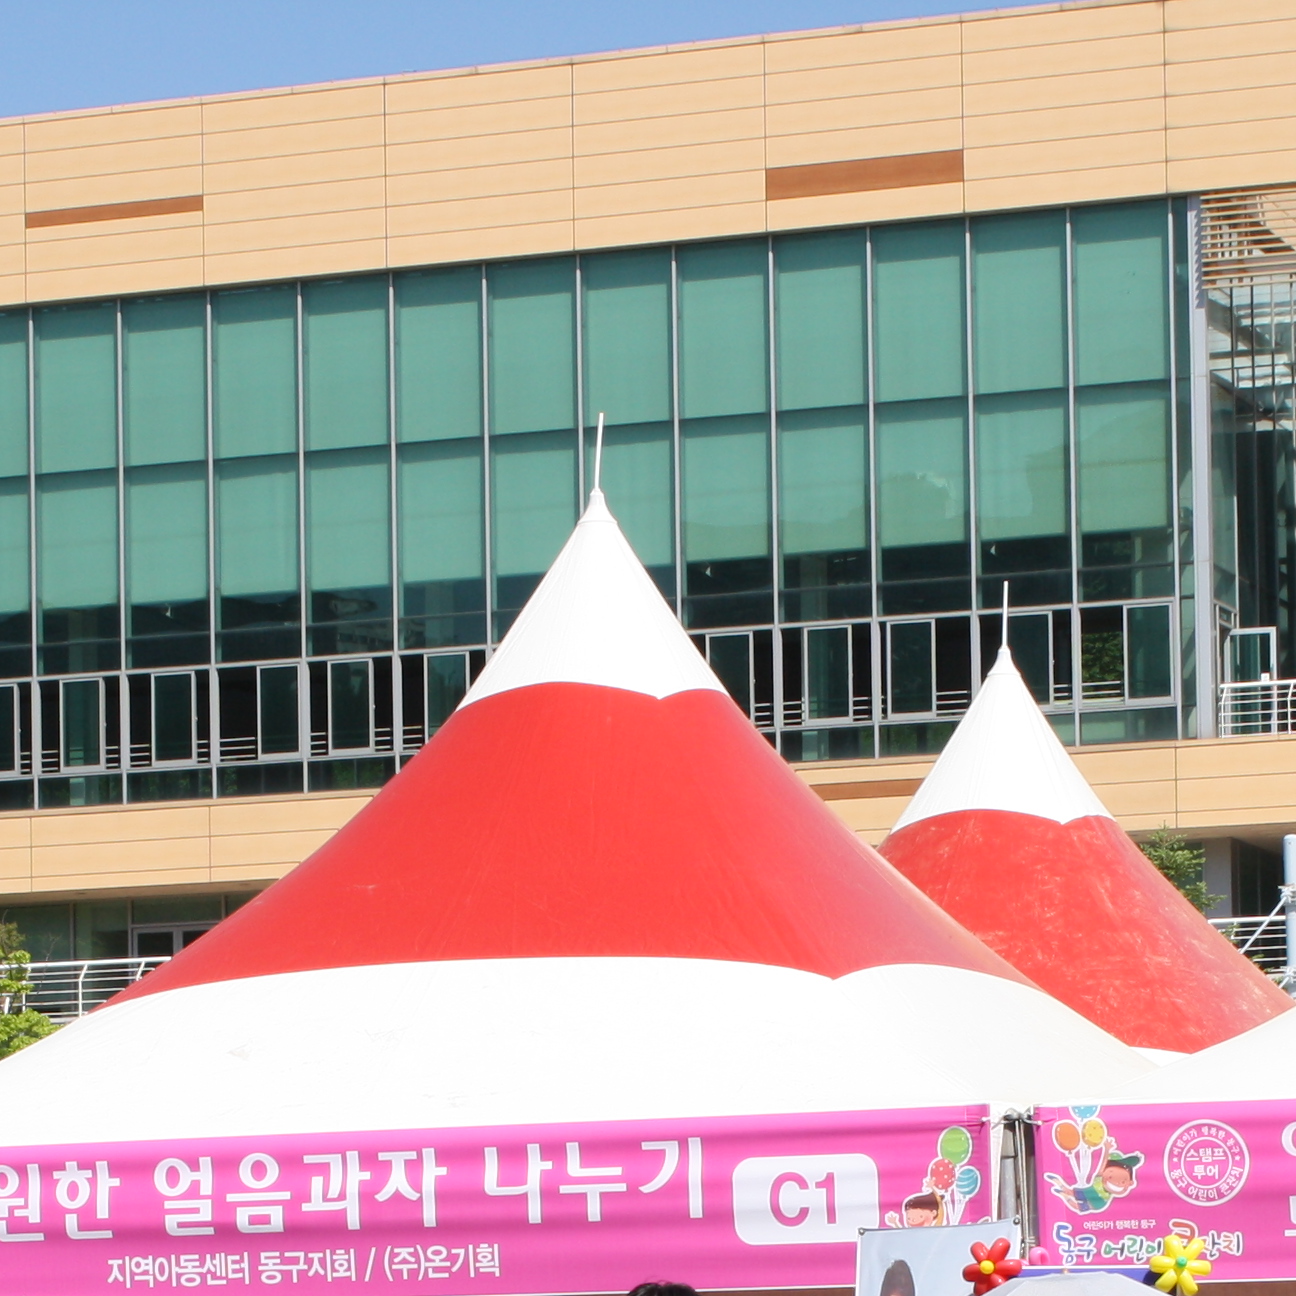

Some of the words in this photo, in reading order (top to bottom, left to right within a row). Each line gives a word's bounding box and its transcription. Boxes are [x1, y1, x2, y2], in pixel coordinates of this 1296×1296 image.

[1186, 1147, 1226, 1163] 스탬프
[1192, 1164, 1219, 1180] 투어
[153, 1149, 448, 1238] 얼음과자
[483, 1137, 703, 1223] 나누기
[769, 1171, 839, 1228] C1
[1188, 1186, 1219, 1201] 어린이
[107, 1251, 250, 1289] 지역아동센터
[258, 1248, 357, 1285] 동구지회
[383, 1243, 501, 1282] (주)온기획
[1054, 1222, 1096, 1266] 동구
[1102, 1235, 1164, 1263] 어린이
